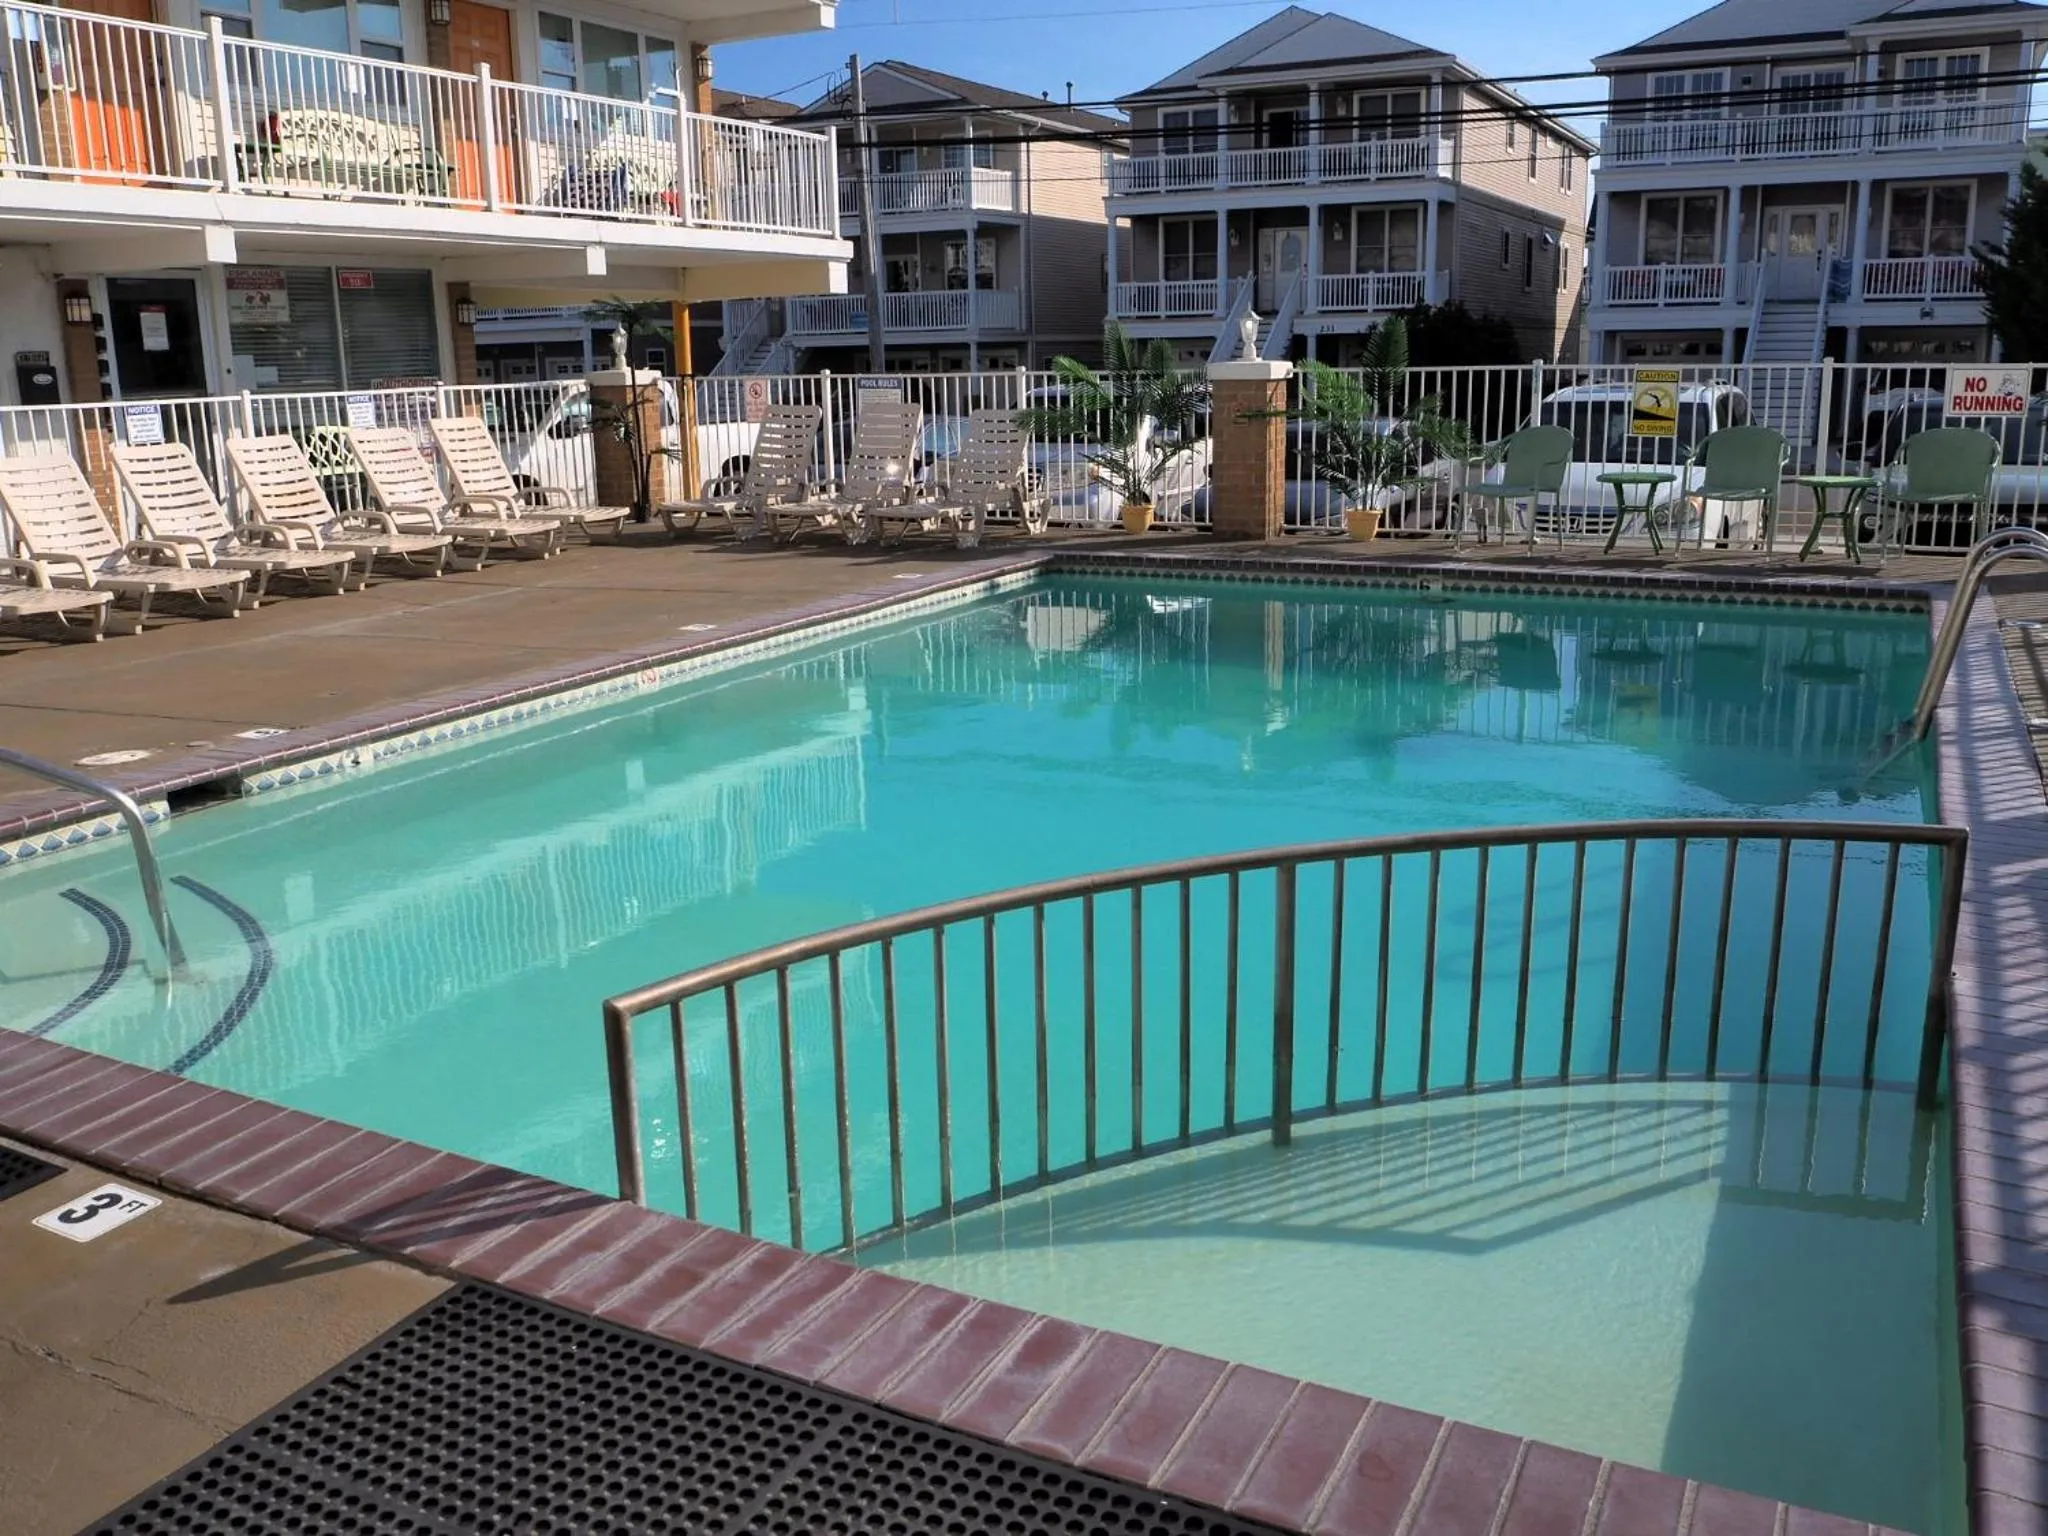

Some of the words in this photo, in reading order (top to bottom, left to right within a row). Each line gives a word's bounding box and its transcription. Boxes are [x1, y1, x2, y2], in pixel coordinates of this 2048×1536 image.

[861, 379, 877, 388] POOL
[878, 379, 897, 387] RULES
[1965, 376, 1987, 392] NO
[1952, 395, 2024, 411] RUNNING
[127, 405, 157, 414] NOTICE
[1646, 424, 1673, 432] DIVING
[57, 1193, 123, 1224] 3
[119, 1200, 148, 1213] FT
